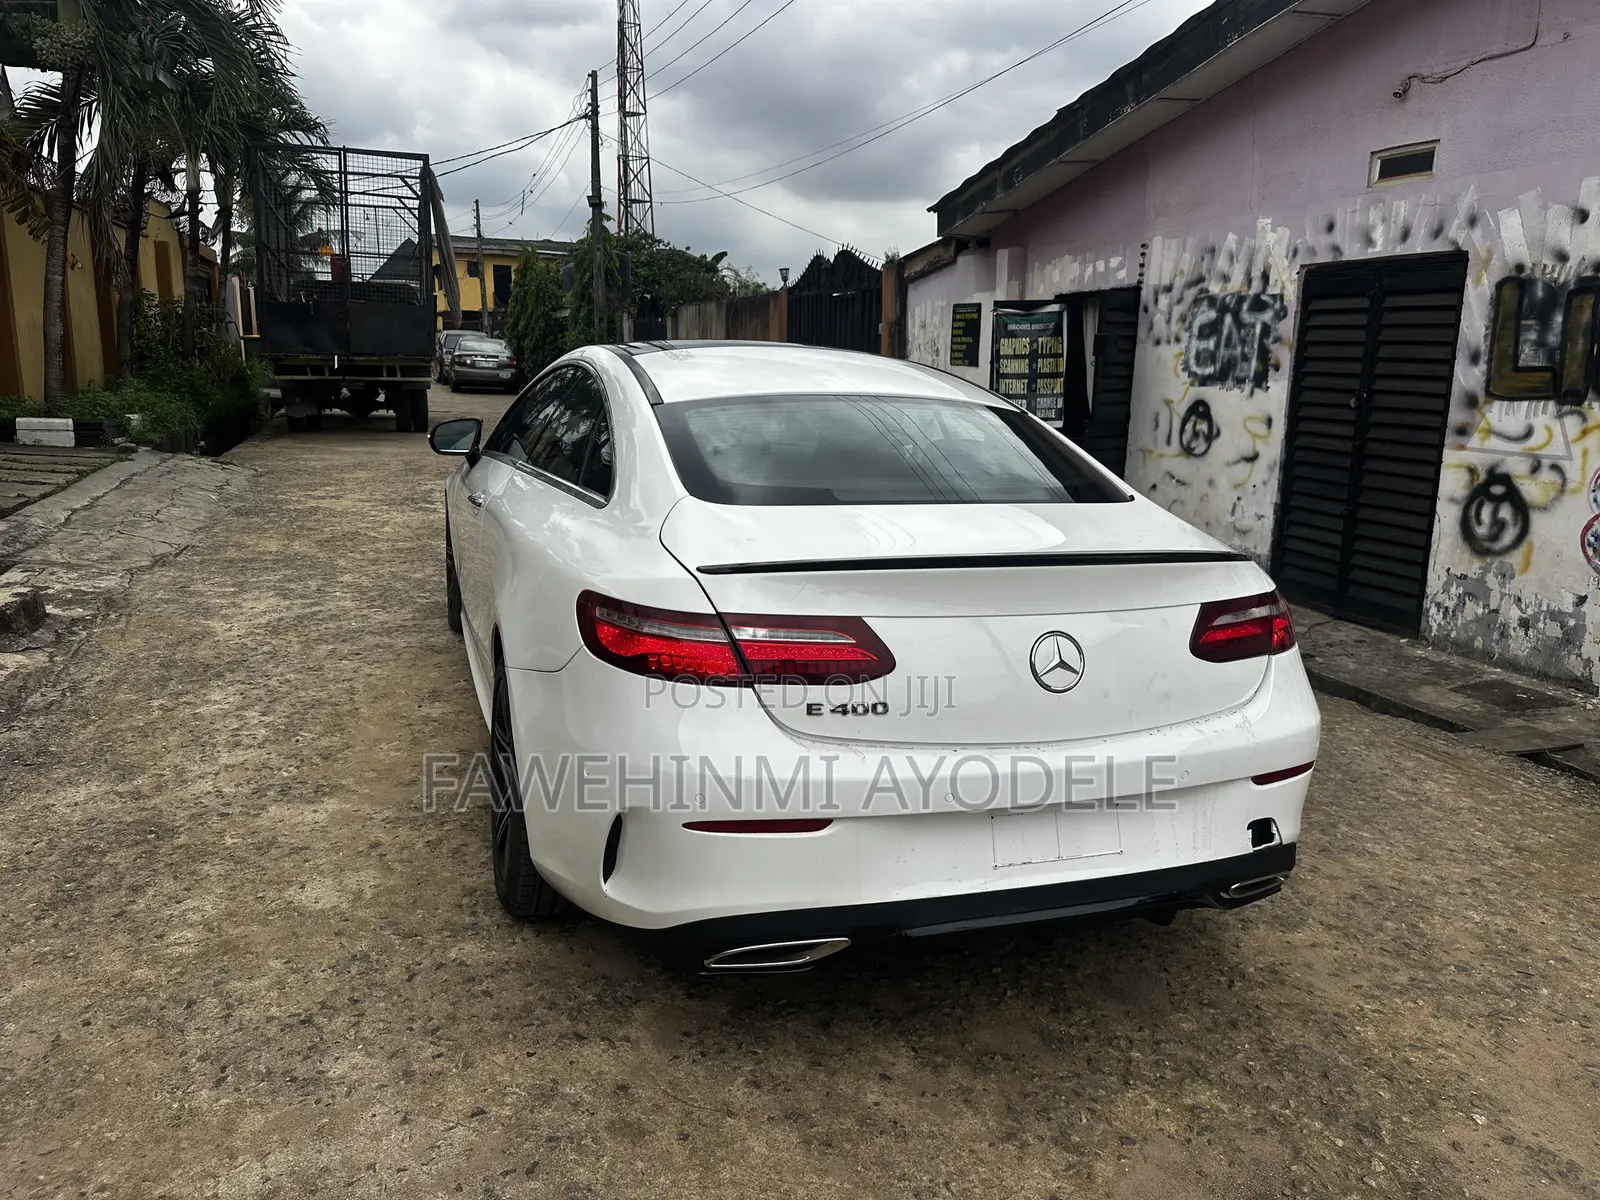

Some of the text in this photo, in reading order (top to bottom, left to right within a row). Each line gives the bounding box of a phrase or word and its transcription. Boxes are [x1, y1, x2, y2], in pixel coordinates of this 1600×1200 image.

[1000, 337, 1030, 355] GRAPHICS
[999, 358, 1029, 374] SCANNING
[999, 378, 1028, 395] INTERNET
[806, 702, 890, 716] E 400
